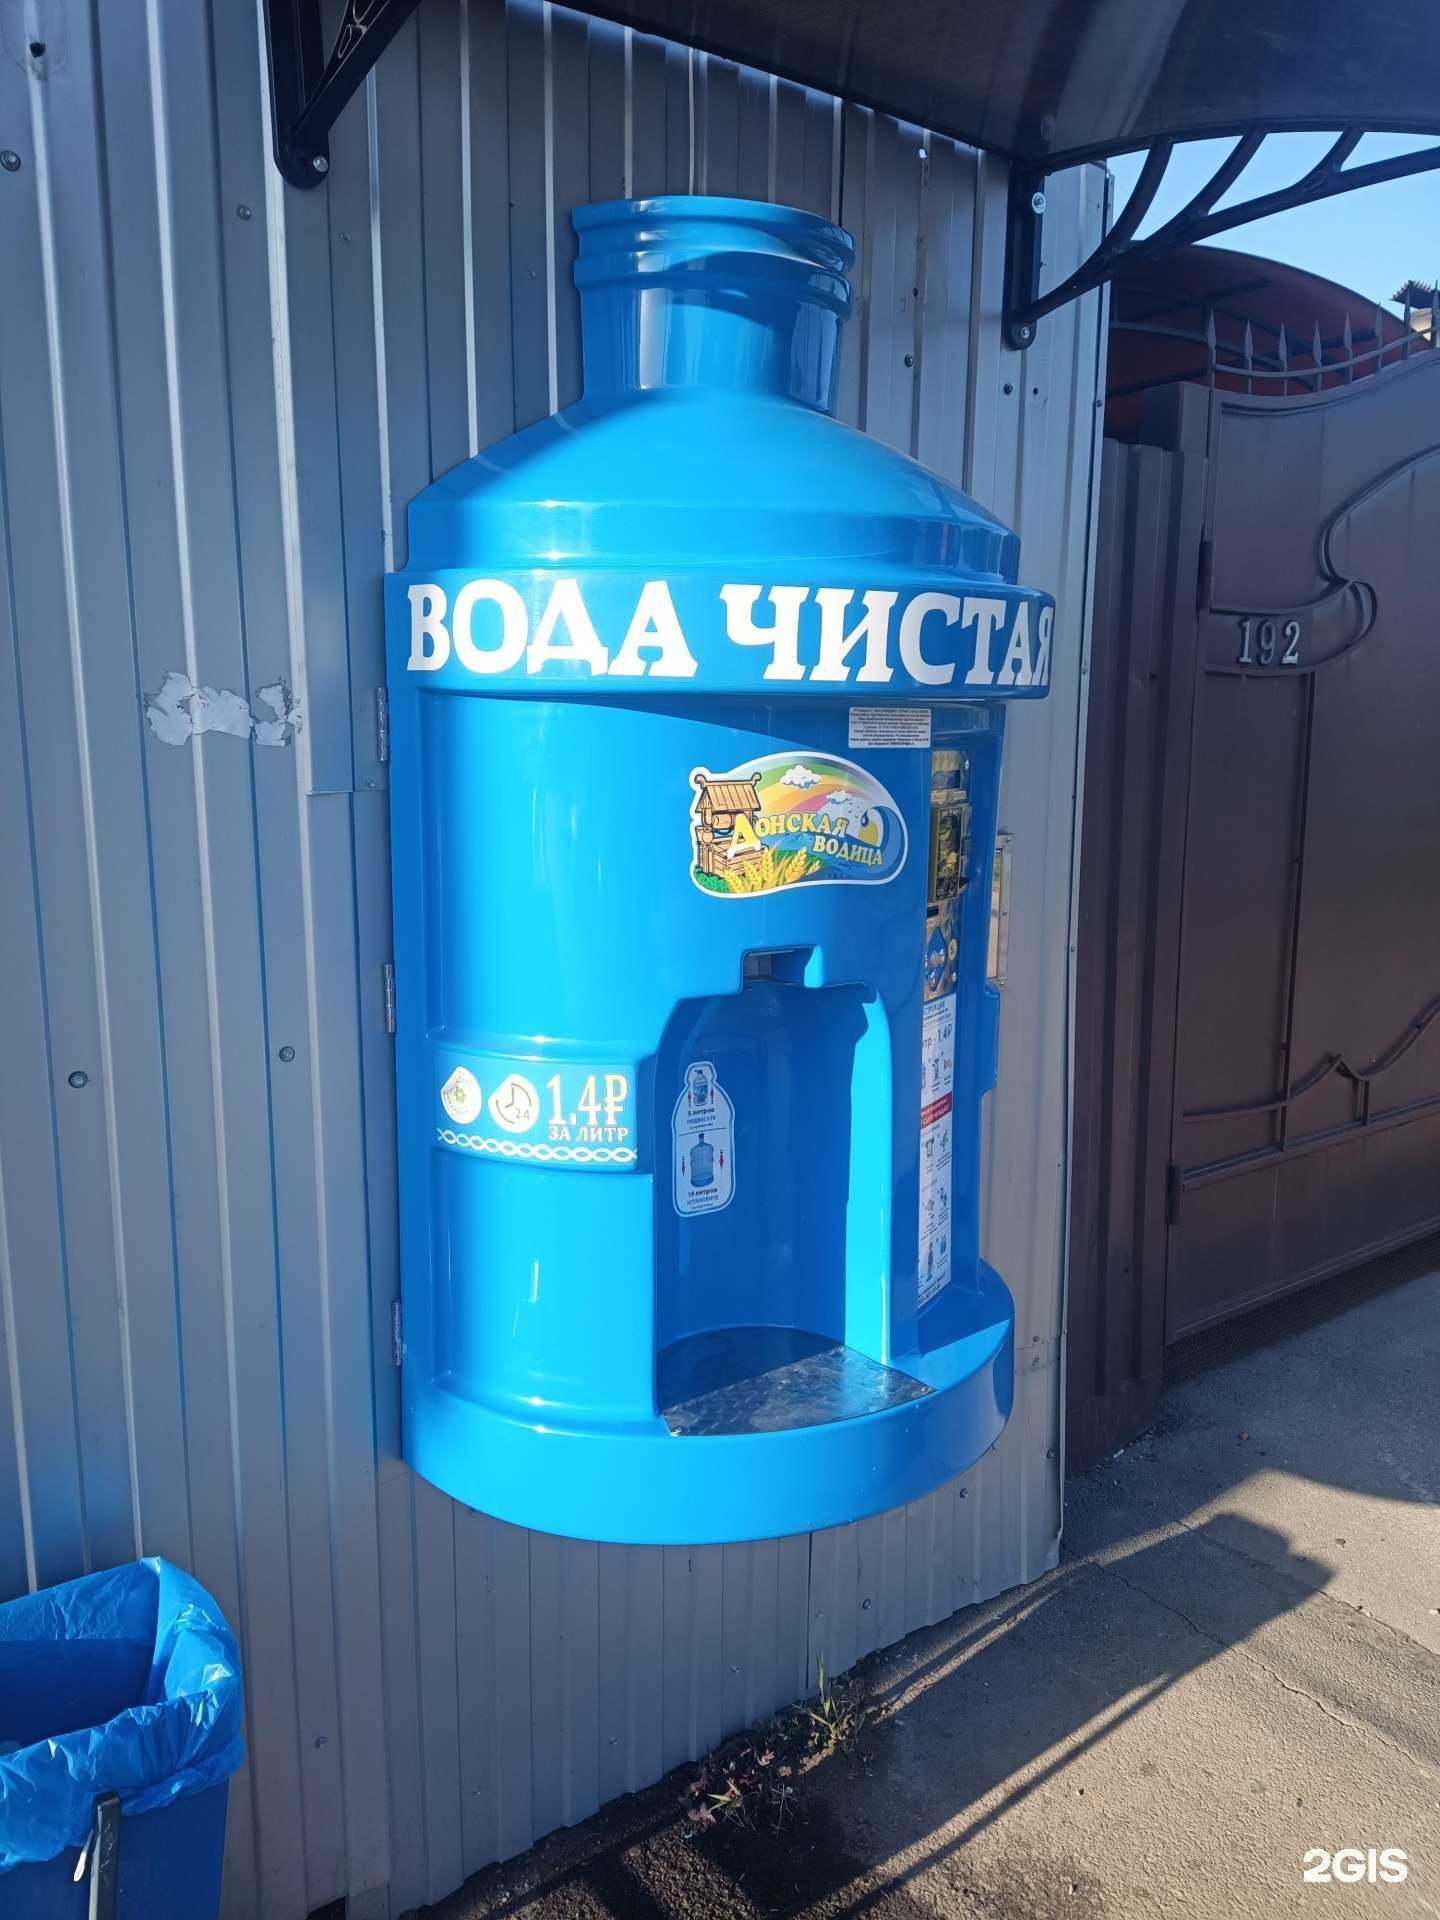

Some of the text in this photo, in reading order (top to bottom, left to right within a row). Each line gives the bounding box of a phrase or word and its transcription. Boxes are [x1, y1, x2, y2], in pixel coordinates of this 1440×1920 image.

[406, 579, 1055, 686] ВОДА ЧИСТАЯ
[1239, 620, 1300, 665] 192
[812, 834, 884, 866] ВОДИЦА
[548, 1126, 629, 1143] ЗА ЛИТР
